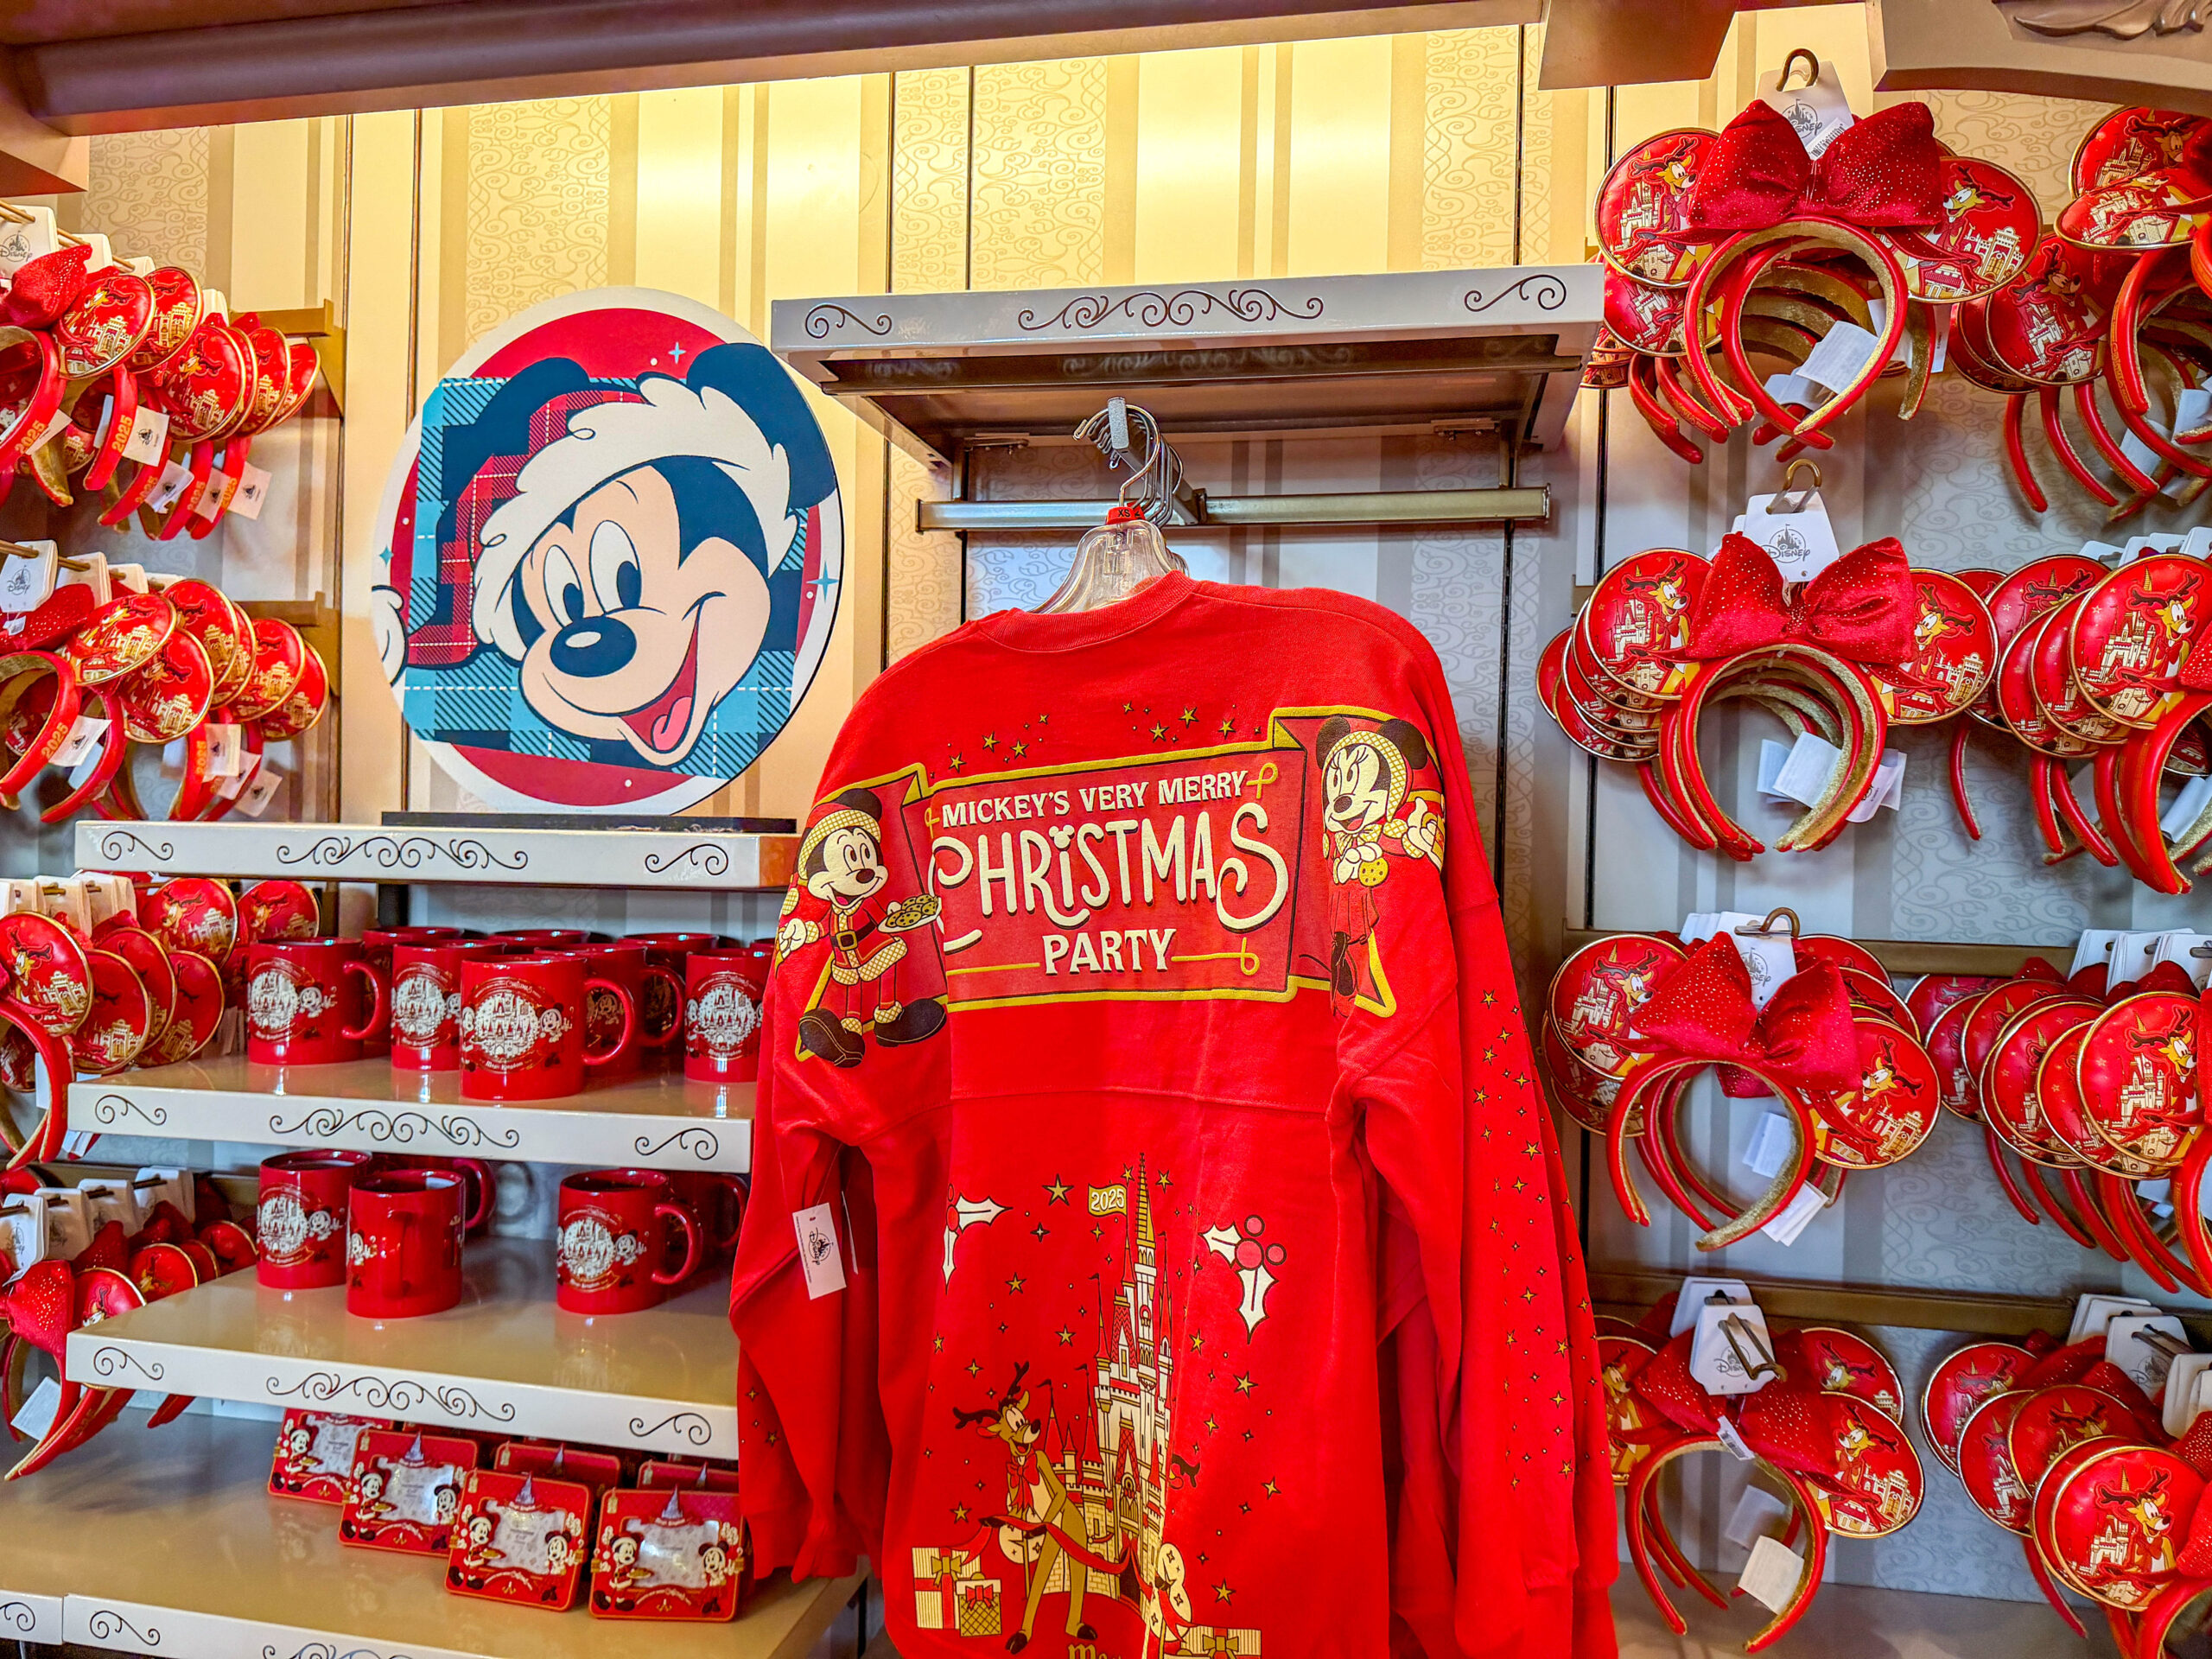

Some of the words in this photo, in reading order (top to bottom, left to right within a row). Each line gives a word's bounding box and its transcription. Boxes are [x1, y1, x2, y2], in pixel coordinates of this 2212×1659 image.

[15, 420, 48, 454] 2025
[112, 416, 132, 452] 2025
[1118, 509, 1131, 518] XS
[41, 722, 69, 760] 2025
[941, 791, 1071, 830] MICKEY'S
[1077, 781, 1149, 813] VERY
[1158, 770, 1249, 805] MERRY
[1042, 927, 1178, 976] PARTY
[1090, 1188, 1125, 1212] 2025
